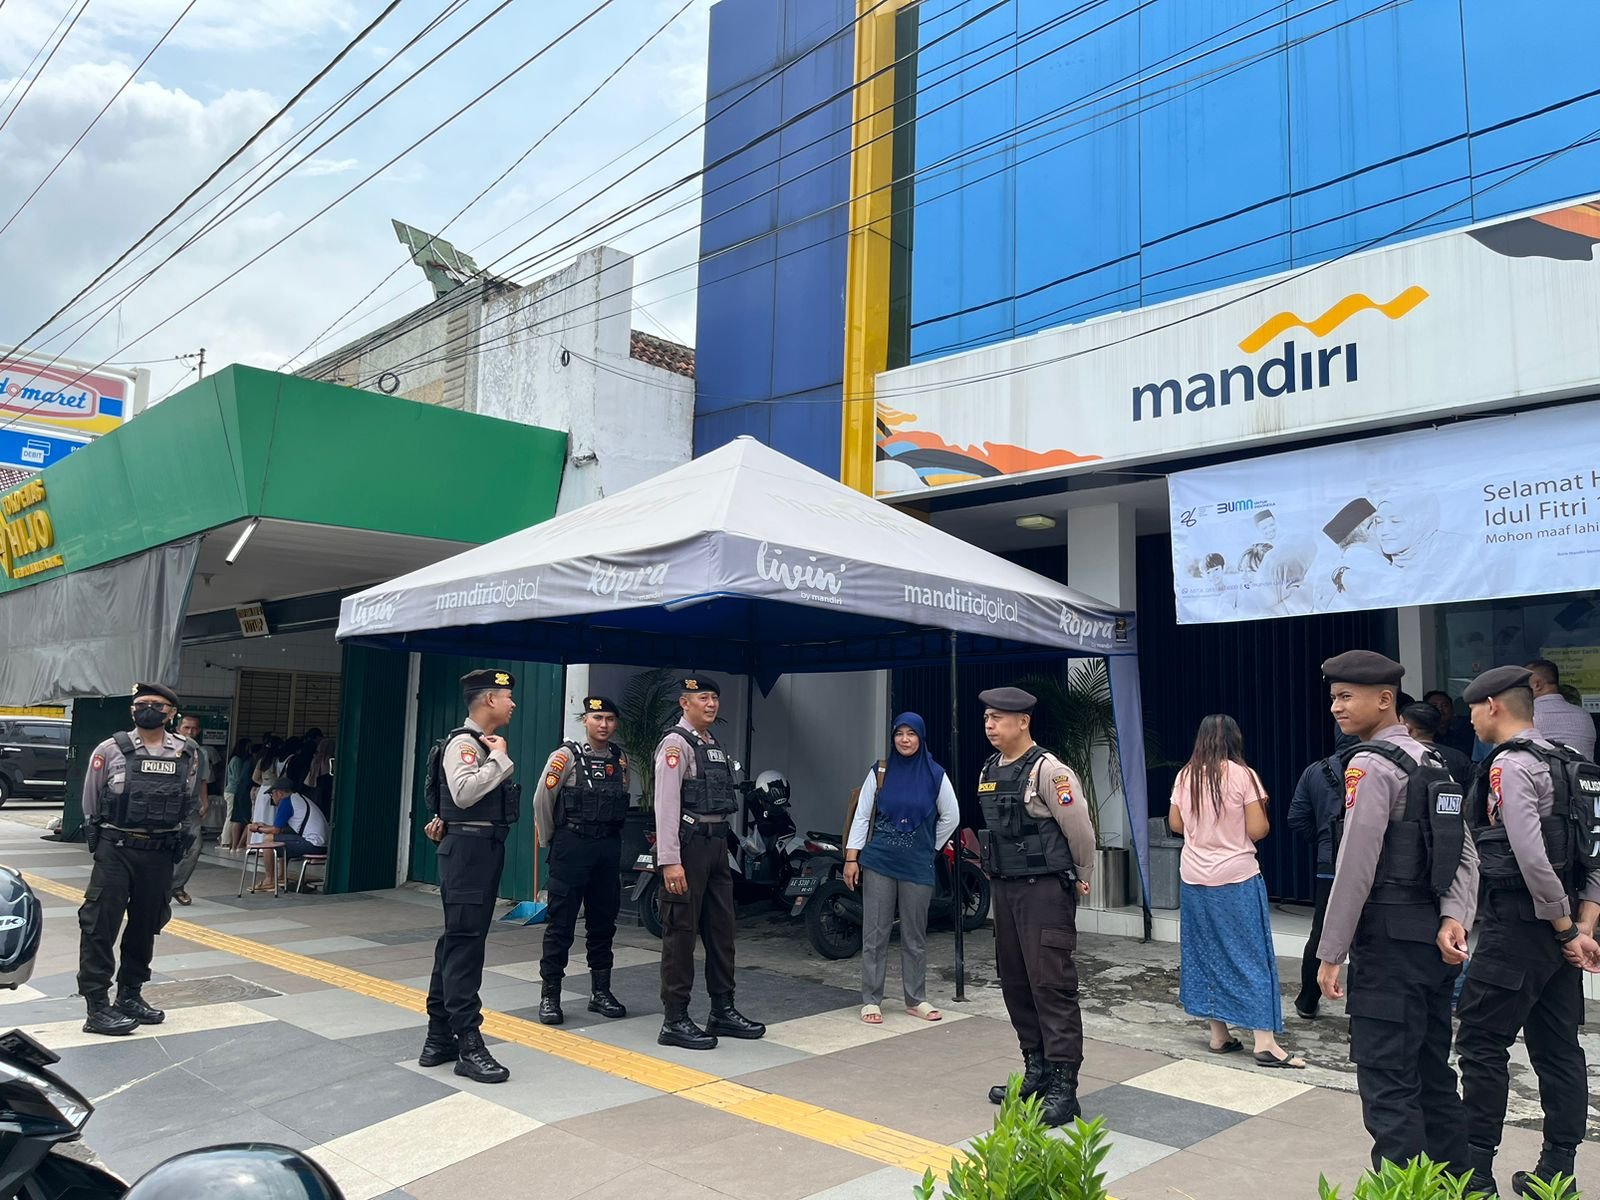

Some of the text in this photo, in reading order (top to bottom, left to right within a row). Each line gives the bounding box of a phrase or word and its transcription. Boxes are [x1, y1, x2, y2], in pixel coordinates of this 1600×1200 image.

[1132, 341, 1358, 422] mandiri
[23, 450, 43, 460] DEBIT
[1483, 474, 1584, 502] Selamat
[1485, 497, 1587, 527] Idul Fitri
[1485, 532, 1533, 544] Mohon
[1537, 524, 1572, 539] maaf
[800, 591, 843, 605] by mandiri
[144, 762, 173, 772] POLISI
